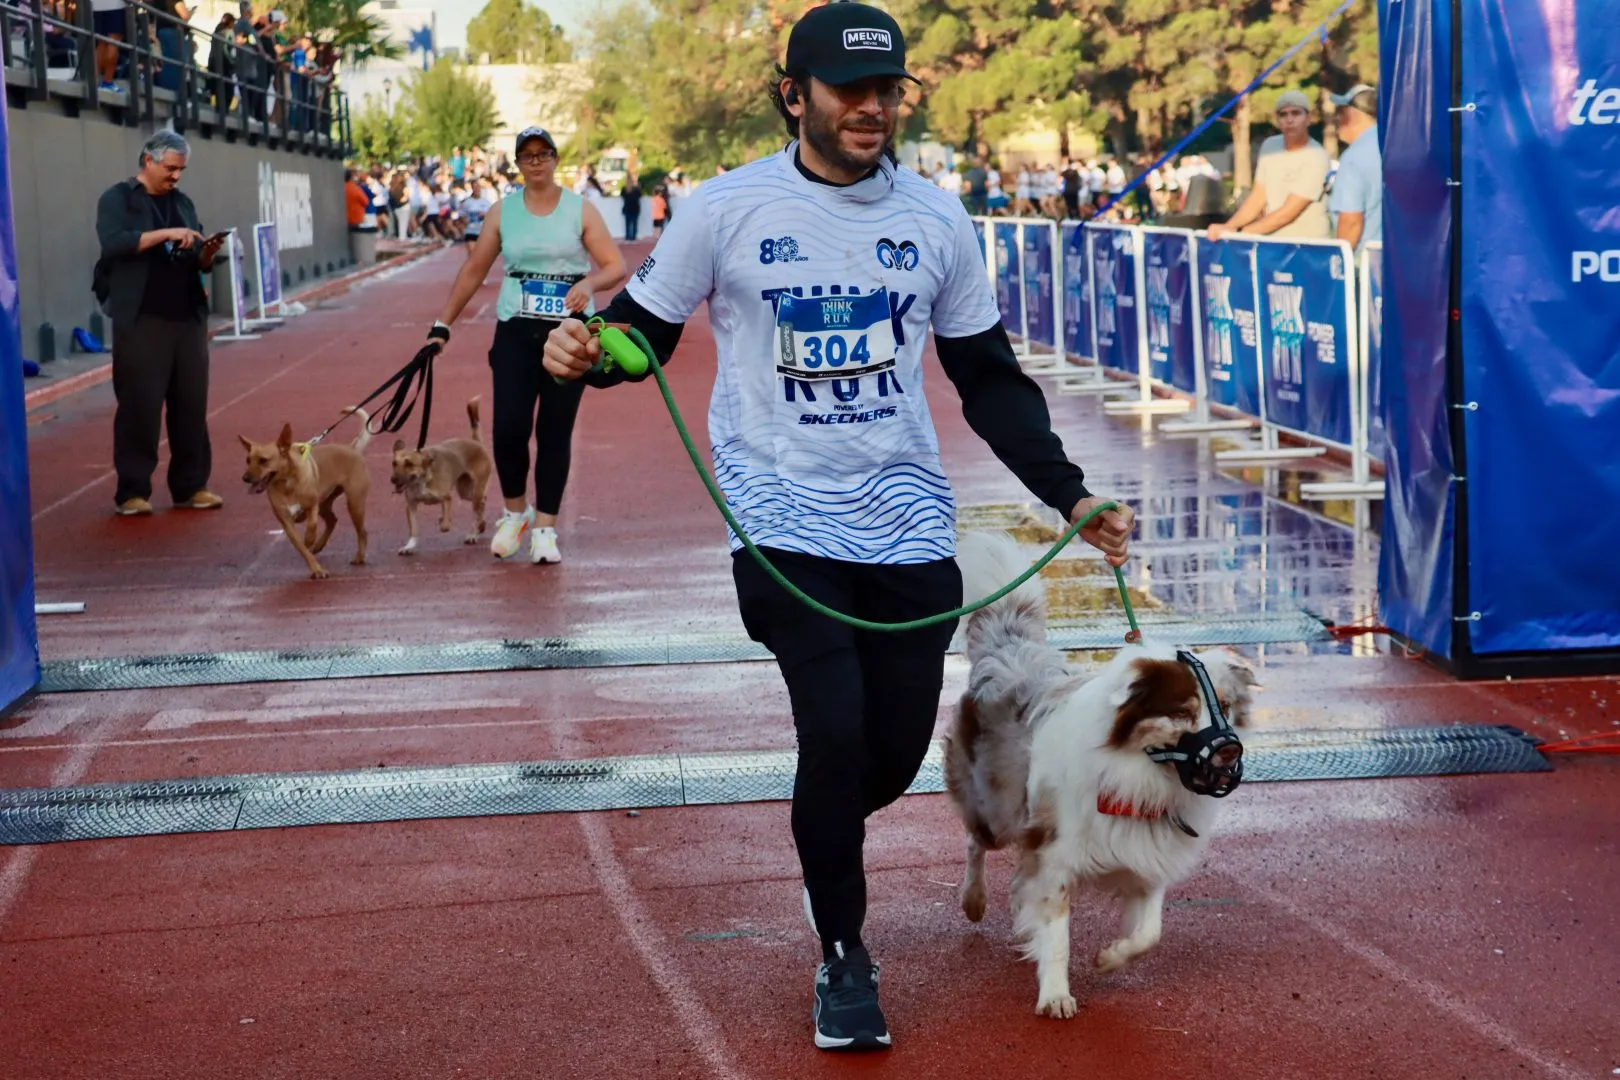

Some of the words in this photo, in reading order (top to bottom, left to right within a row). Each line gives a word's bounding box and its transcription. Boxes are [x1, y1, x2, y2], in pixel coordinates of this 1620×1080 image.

[848, 32, 889, 45] MELVIN
[1568, 79, 1620, 125] te
[535, 297, 564, 313] 289
[820, 301, 853, 313] THINK
[823, 313, 850, 324] RUN
[803, 333, 871, 369] 304
[799, 405, 897, 424] SKECHERS
